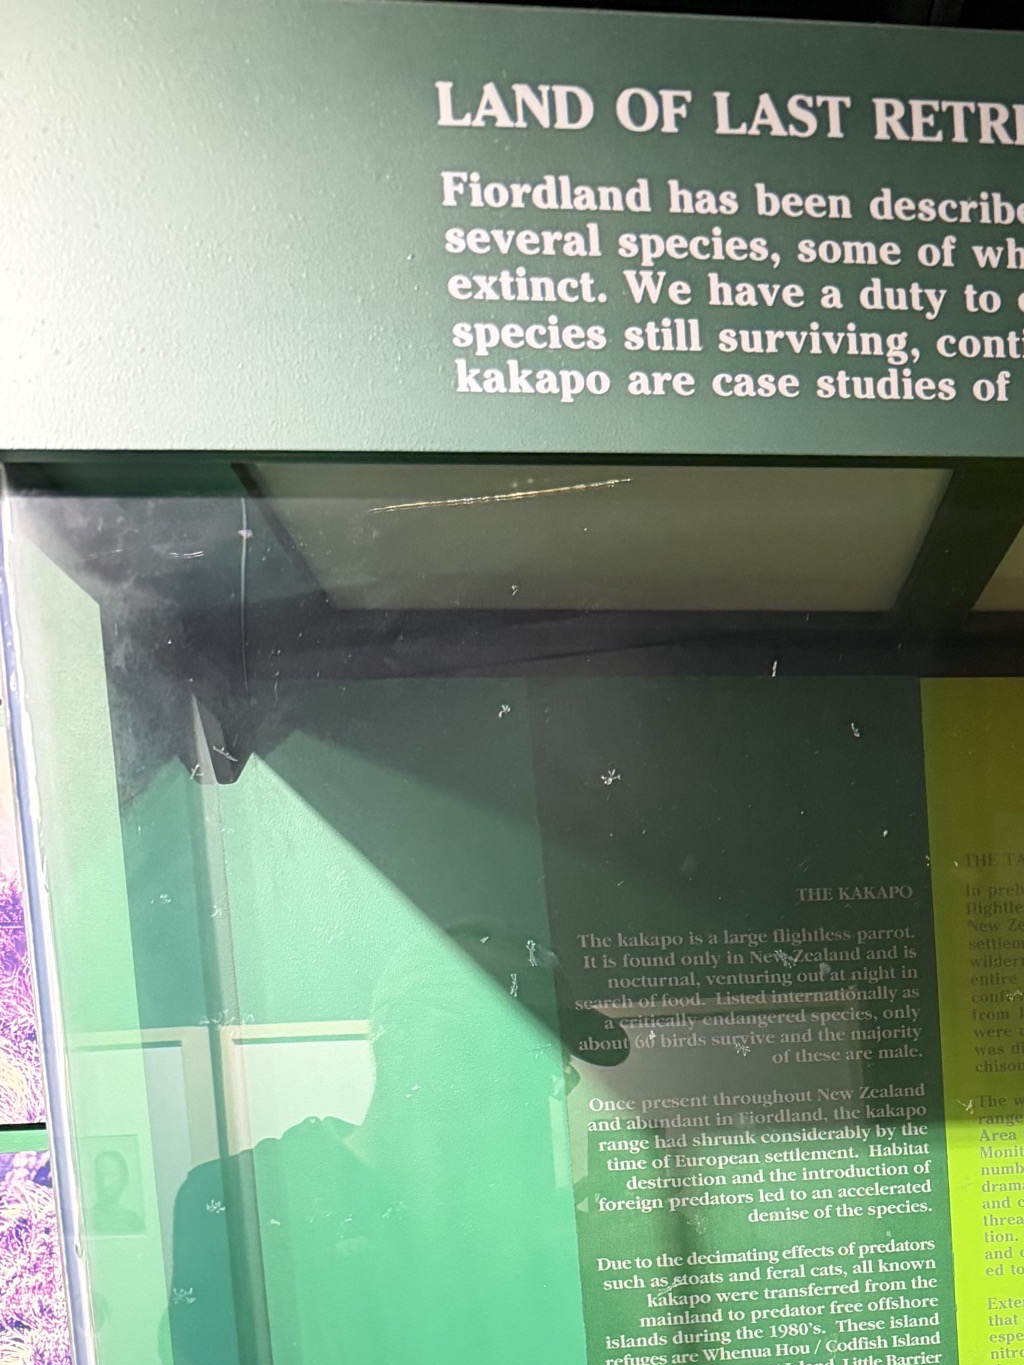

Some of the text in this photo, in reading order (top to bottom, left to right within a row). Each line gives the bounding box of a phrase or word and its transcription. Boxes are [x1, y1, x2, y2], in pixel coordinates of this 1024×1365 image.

[434, 80, 593, 129] LAND
[615, 87, 691, 132] OF
[712, 90, 851, 138] LAST
[440, 170, 651, 212] Fiordland
[667, 178, 738, 214] has
[754, 182, 852, 218] been
[444, 222, 601, 256] several
[617, 226, 780, 268] species,
[797, 238, 901, 265] some
[917, 234, 956, 267] of
[447, 266, 607, 302] extinct.
[622, 269, 691, 305] We
[707, 271, 804, 307] have
[820, 284, 843, 308] a
[859, 277, 947, 320] duty
[963, 283, 1001, 313] to
[452, 314, 606, 355] species
[624, 317, 702, 351] still
[718, 321, 920, 365] surviving,
[454, 358, 610, 402] kakapo
[627, 370, 694, 396] are
[711, 372, 799, 397] case
[816, 367, 956, 400] studies
[972, 370, 1010, 401] of
[964, 853, 999, 867] THE
[795, 884, 913, 901] THE KAKAPO
[576, 926, 915, 950] The kakapo is a large flightless parrot.
[771, 1043, 922, 1063] of these are male.
[588, 1082, 925, 1113] Once present throughout New Zealand
[979, 1129, 1017, 1141] Area
[625, 1159, 932, 1190] destruction and the introduction of
[747, 1199, 932, 1222] demise of the species.
[596, 1238, 935, 1271] Due to the decimating effects of predators
[985, 1263, 1004, 1276] ed
[1010, 1264, 1024, 1275] to
[605, 1332, 667, 1349] islands
[672, 1329, 731, 1344] during
[735, 1325, 763, 1339] the
[834, 1318, 885, 1335] These
[889, 1311, 940, 1328] island
